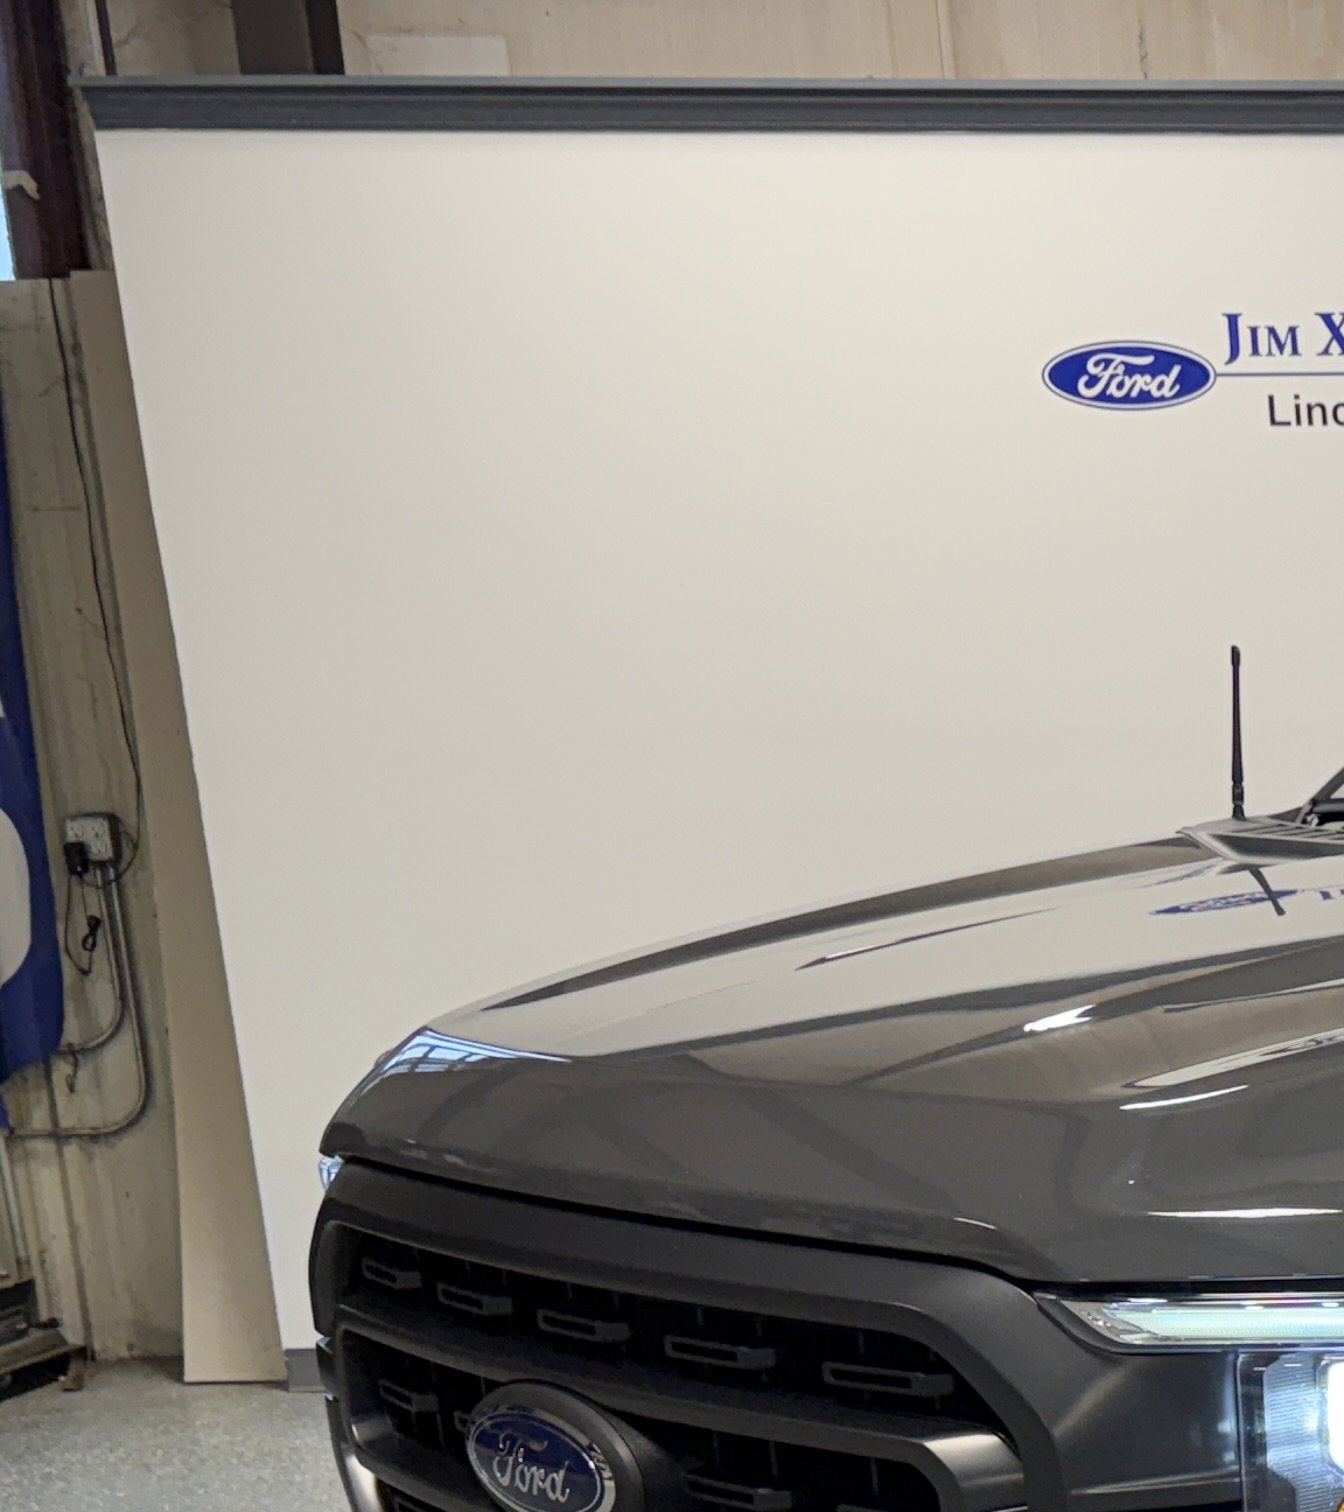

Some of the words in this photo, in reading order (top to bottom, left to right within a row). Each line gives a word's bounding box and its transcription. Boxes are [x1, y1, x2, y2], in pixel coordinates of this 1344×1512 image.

[1221, 312, 1299, 365] JIM
[1077, 353, 1180, 400] Ford
[492, 1427, 571, 1504] Ford
